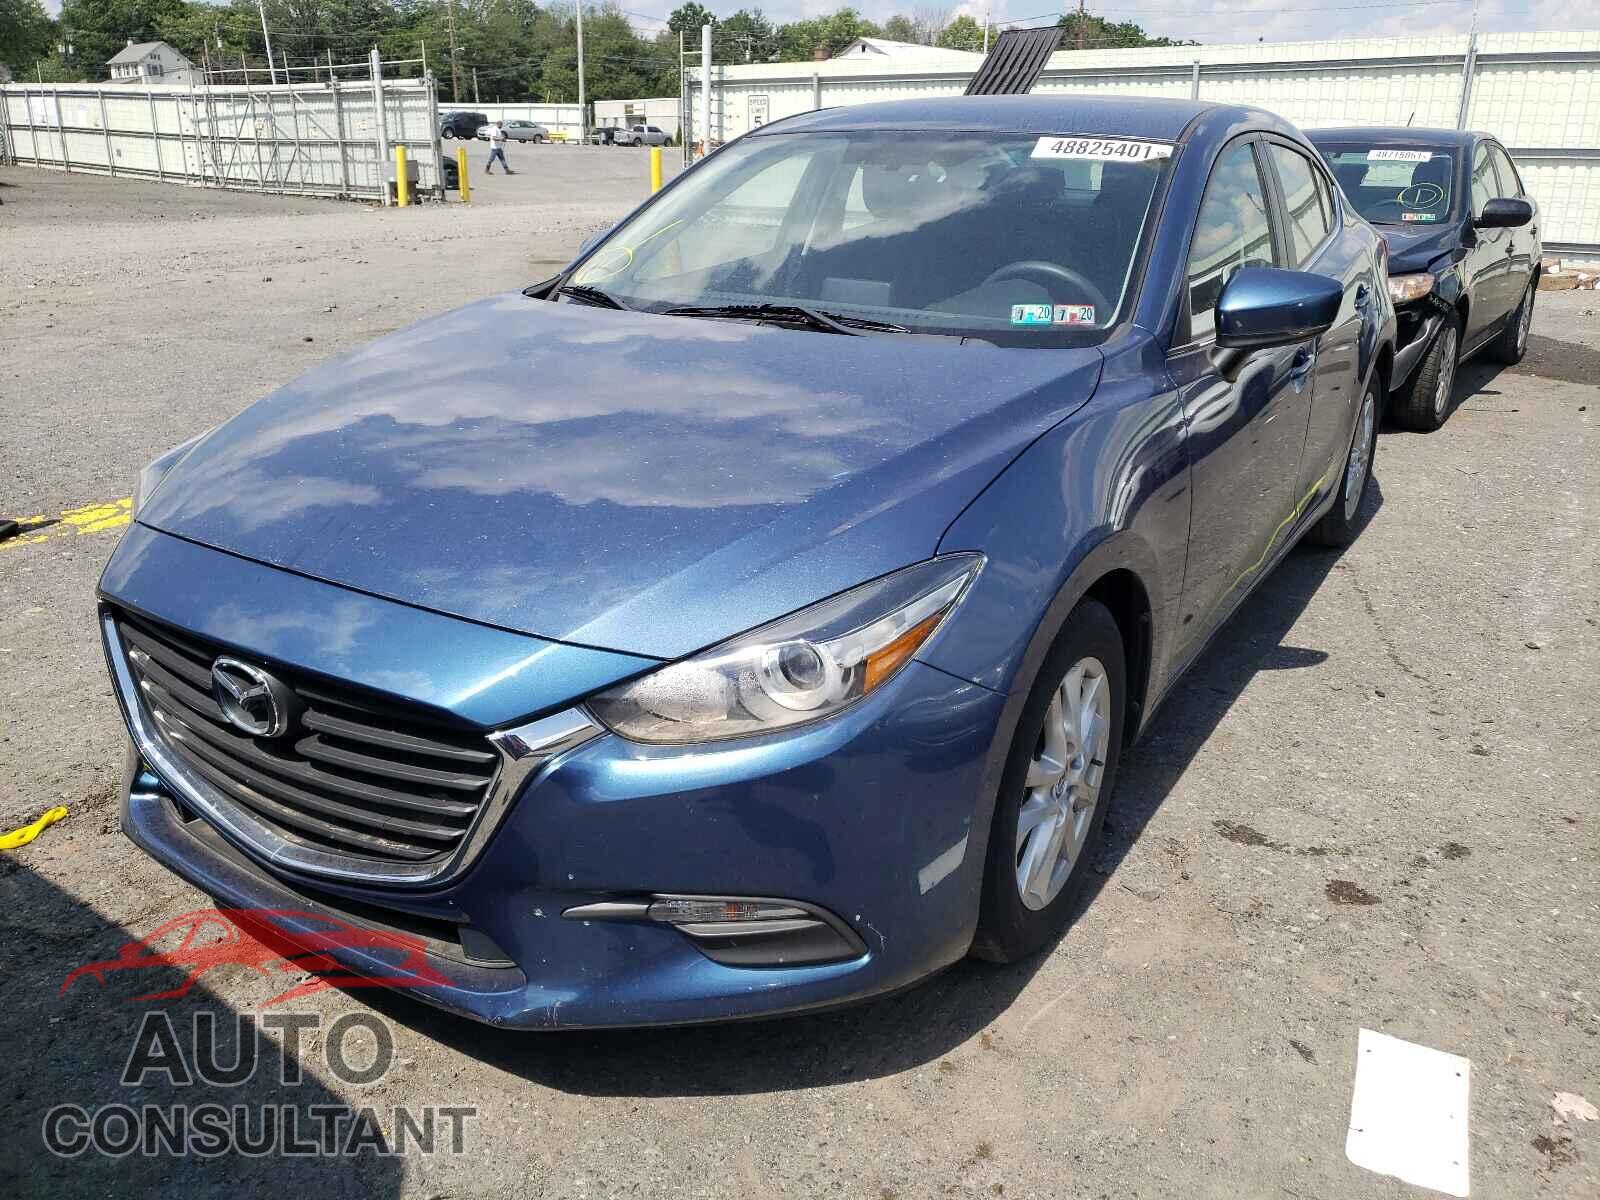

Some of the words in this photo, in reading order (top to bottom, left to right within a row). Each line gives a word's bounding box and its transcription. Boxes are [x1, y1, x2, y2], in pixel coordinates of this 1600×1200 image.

[1051, 140, 1152, 159] 48825401
[1039, 306, 1050, 319] 20
[1081, 307, 1093, 321] 20
